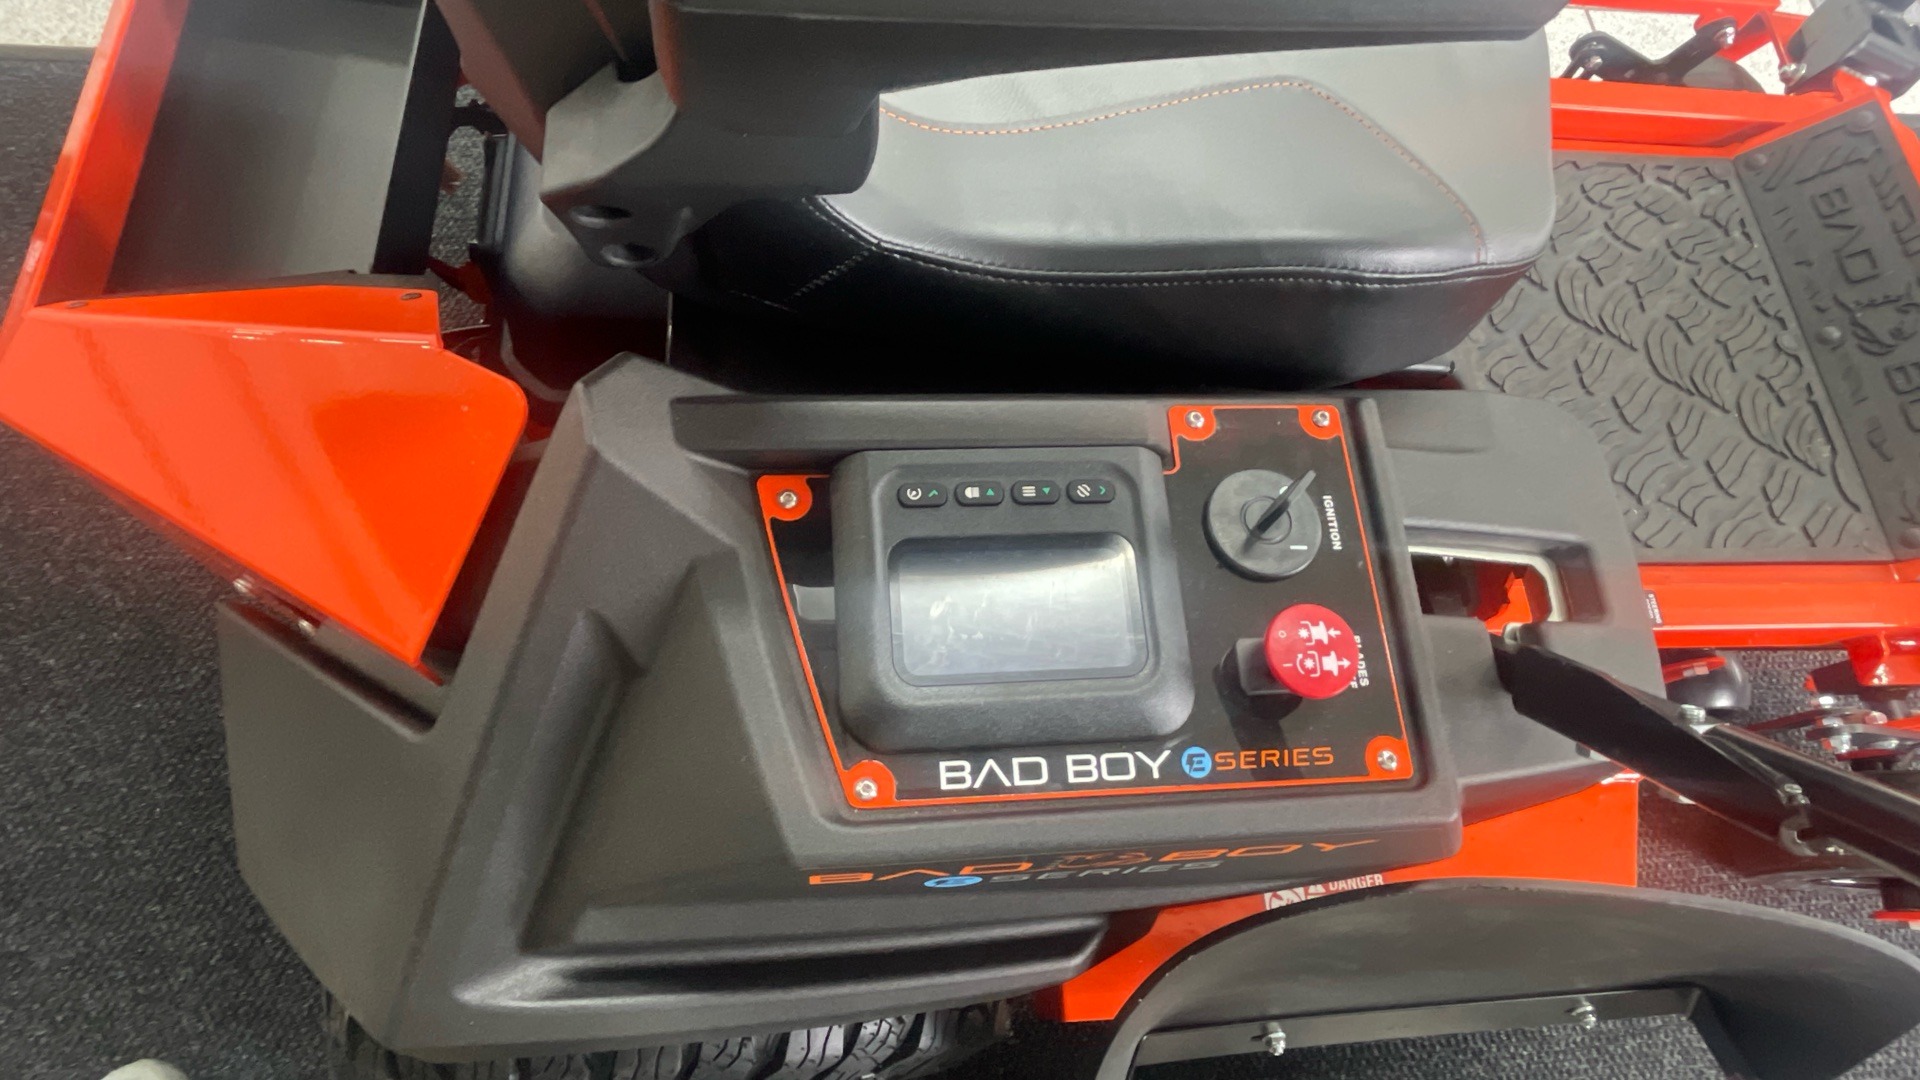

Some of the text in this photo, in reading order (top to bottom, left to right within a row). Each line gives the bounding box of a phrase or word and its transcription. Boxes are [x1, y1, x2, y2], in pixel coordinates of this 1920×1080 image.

[1811, 187, 1880, 284] BAD
[1322, 494, 1343, 551] IGNITION
[938, 755, 1050, 791] BAD
[1066, 749, 1172, 784] BOY
[1214, 747, 1335, 771] SERIES
[808, 839, 1381, 886] BAD BOY
[988, 860, 1225, 884] SERIES
[1328, 872, 1385, 892] DANGER
